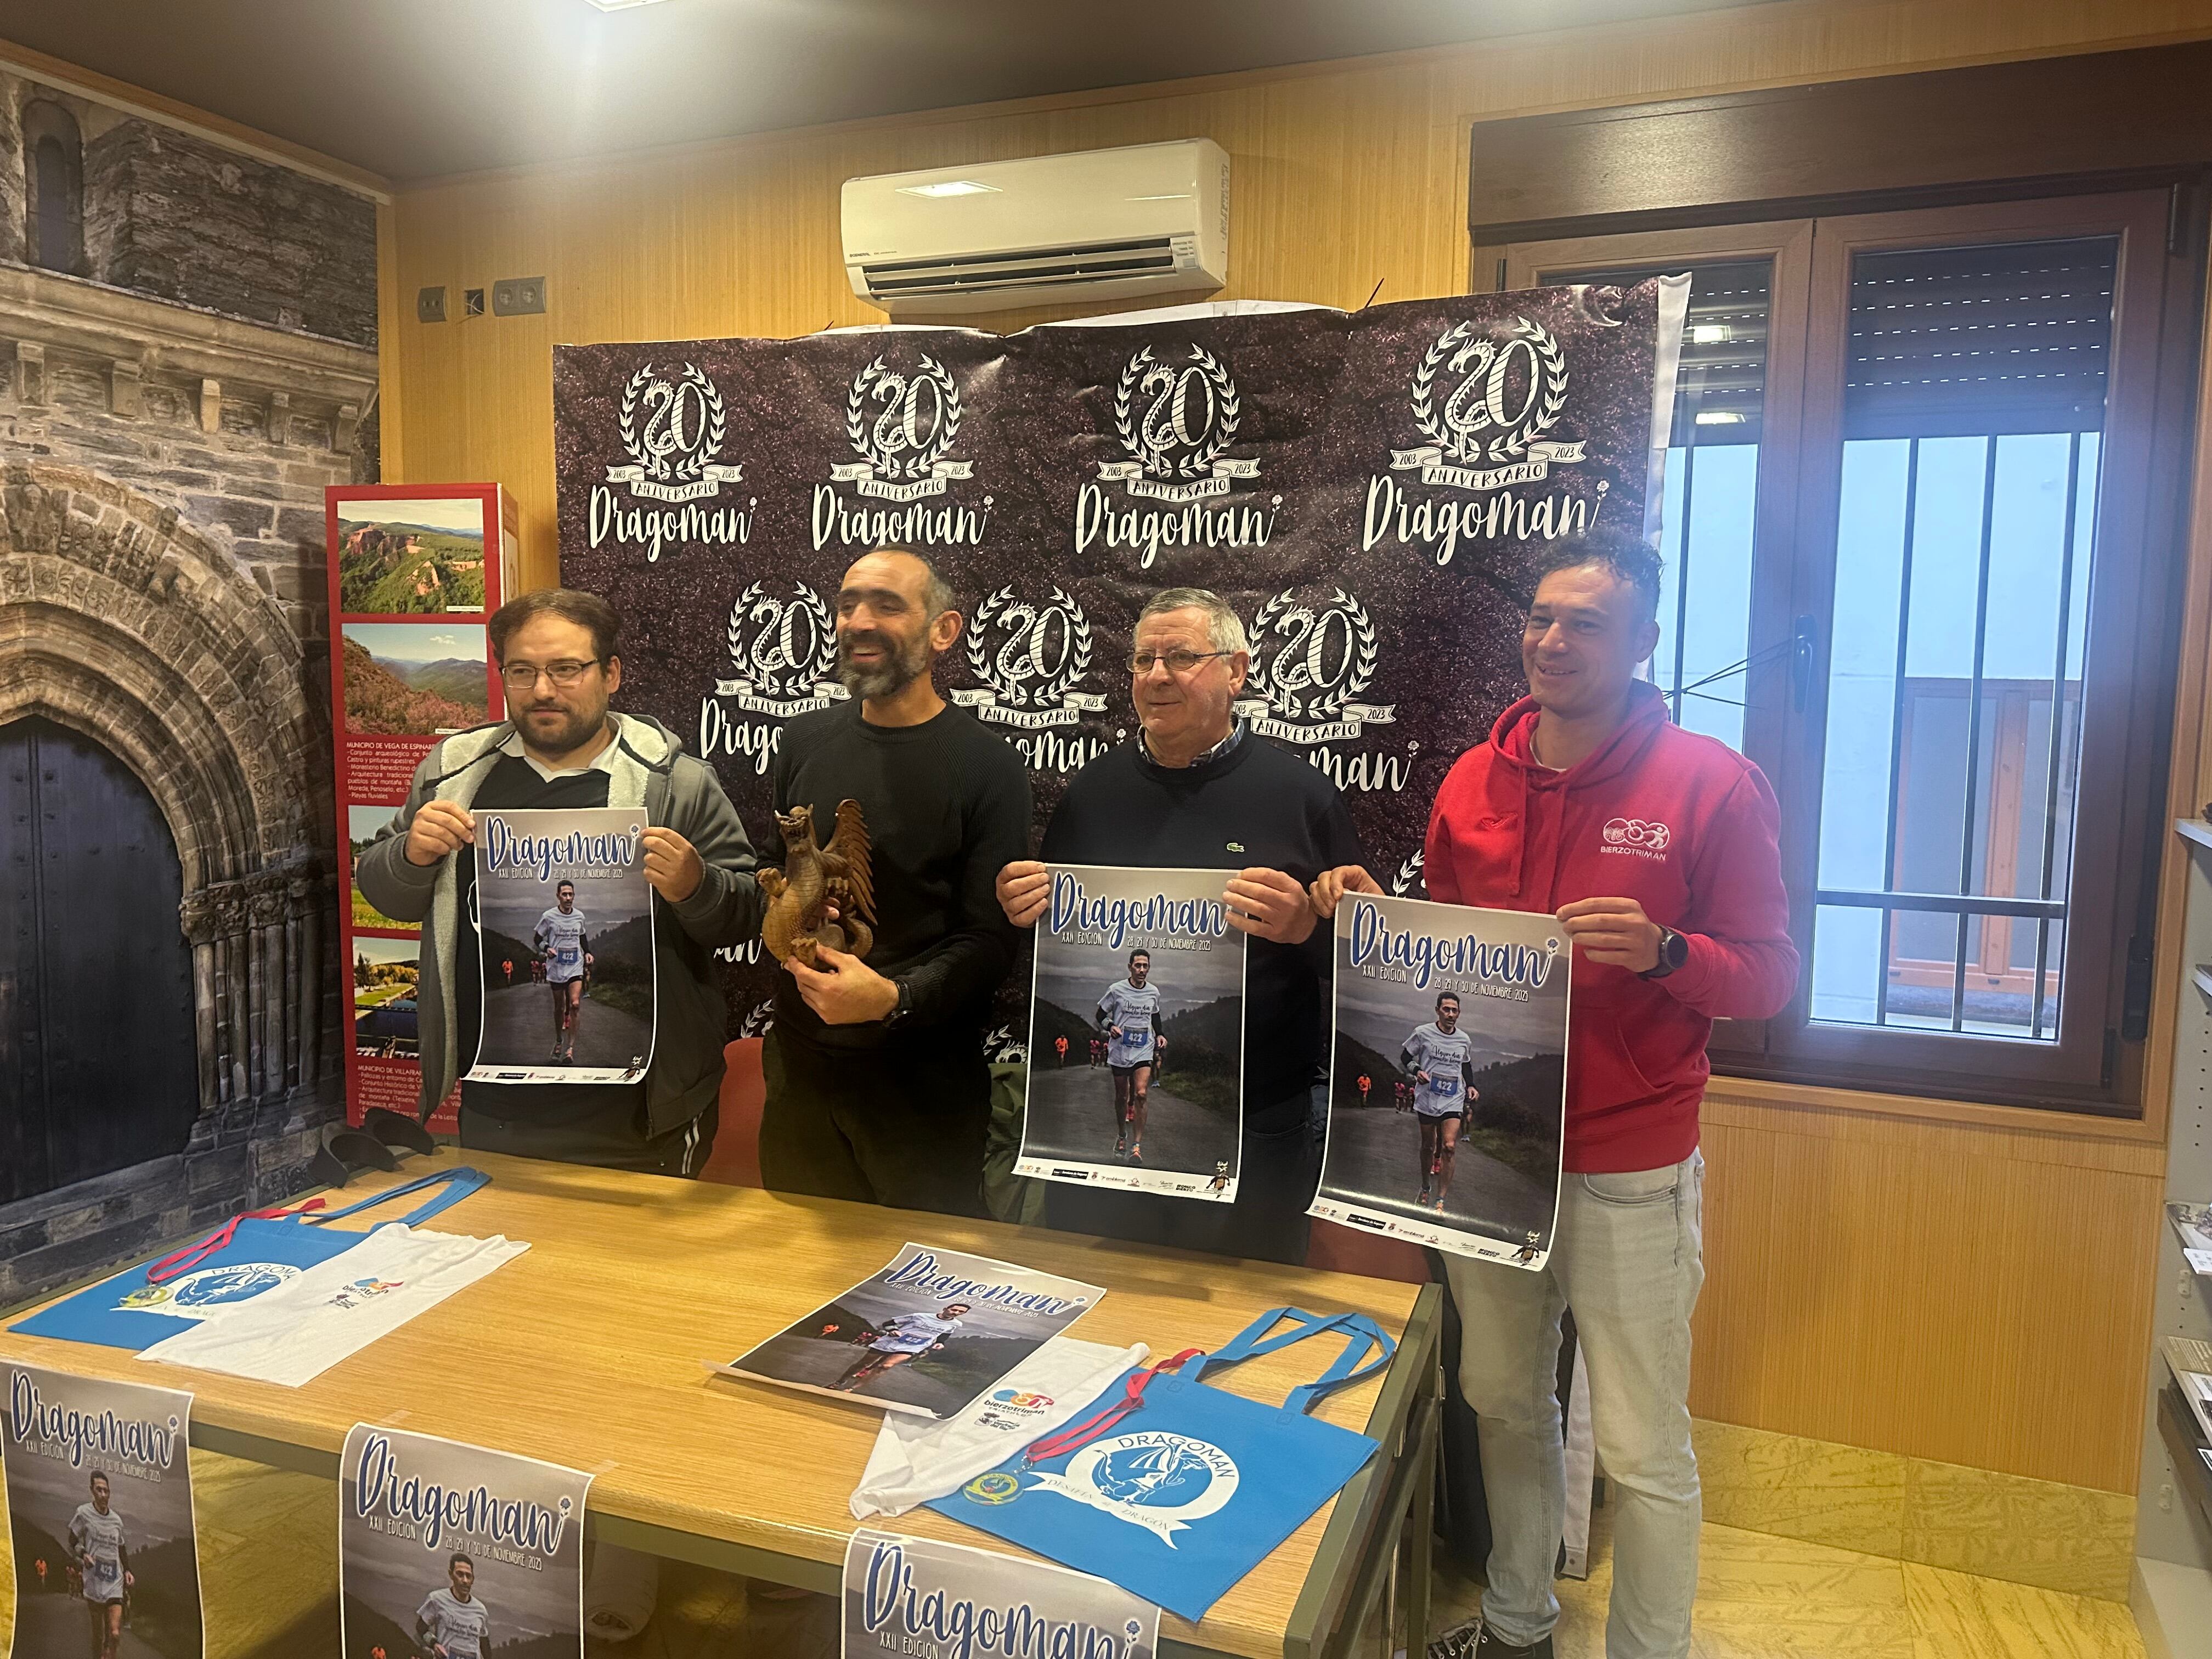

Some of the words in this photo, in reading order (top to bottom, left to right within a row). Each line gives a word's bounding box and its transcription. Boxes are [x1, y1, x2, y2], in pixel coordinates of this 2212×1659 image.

[1400, 452, 1417, 466] 2003
[1554, 446, 1575, 459] 2023
[613, 470, 627, 479] 2003
[722, 470, 736, 478] 2023
[838, 469, 853, 477] 2003
[951, 466, 966, 476] 2023
[1106, 465, 1122, 476] 2003
[1234, 463, 1251, 474] 2023
[1427, 462, 1544, 487] ANIVERSARIO
[636, 482, 715, 500] ANIVERSARIO
[863, 480, 944, 500] ANIVERSARIO
[1132, 478, 1228, 498] ANIVERSARIO
[590, 484, 756, 562] Dragoman
[814, 483, 992, 551] Dragoman
[1075, 483, 1283, 569] Dragoman
[1363, 475, 1610, 566] Dragoman
[721, 682, 734, 692] 2003
[833, 686, 845, 696] 2023
[743, 697, 827, 715] ANIVERSARIO
[957, 692, 973, 703] 2003
[1084, 697, 1098, 707] 2023
[984, 707, 1075, 726] ANIVERSARIO
[1368, 708, 1385, 719] 2023
[1256, 719, 1357, 741] ANIVERSARIO
[487, 816, 639, 881] Dragoman
[1600, 845, 1666, 861] BIERZOTRIMAN
[1052, 871, 1228, 950] Dragoman
[1062, 932, 1074, 944] XXII
[1077, 930, 1103, 945] EDICIÓN
[1137, 936, 1143, 947] 29
[1146, 937, 1150, 947] Y
[1160, 937, 1167, 949] DE
[1169, 938, 1197, 950] NOVIEMBRE
[1199, 940, 1211, 951] 2025
[1351, 900, 1559, 989] Dragoman
[1362, 964, 1376, 979] XXII
[1380, 966, 1407, 984] EDICIÓN
[1445, 978, 1452, 990] 29
[1454, 980, 1459, 991] Y
[1471, 982, 1479, 994] DE
[1481, 984, 1512, 1000] NOVIEMBRE
[1515, 989, 1529, 1002] 2025
[1128, 1033, 1142, 1042] 422
[1436, 1080, 1452, 1091] 422
[884, 1251, 1086, 1315] Dragoman
[984, 1400, 1045, 1415] bierzotriman
[12, 1370, 178, 1468] Dragoman
[1119, 1433, 1235, 1479] DRAGOMAN
[357, 1434, 571, 1554] Dragoman
[369, 1515, 382, 1532] XXII
[387, 1519, 416, 1540] EDICIÓN
[456, 1537, 463, 1551] 29
[466, 1541, 471, 1554] Y
[483, 1543, 491, 1558] DE
[493, 1545, 526, 1567] NOVIEMBRE
[528, 1556, 543, 1571] 2025
[879, 1630, 896, 1651] XXII
[902, 1636, 939, 1659] EDICIÓN
